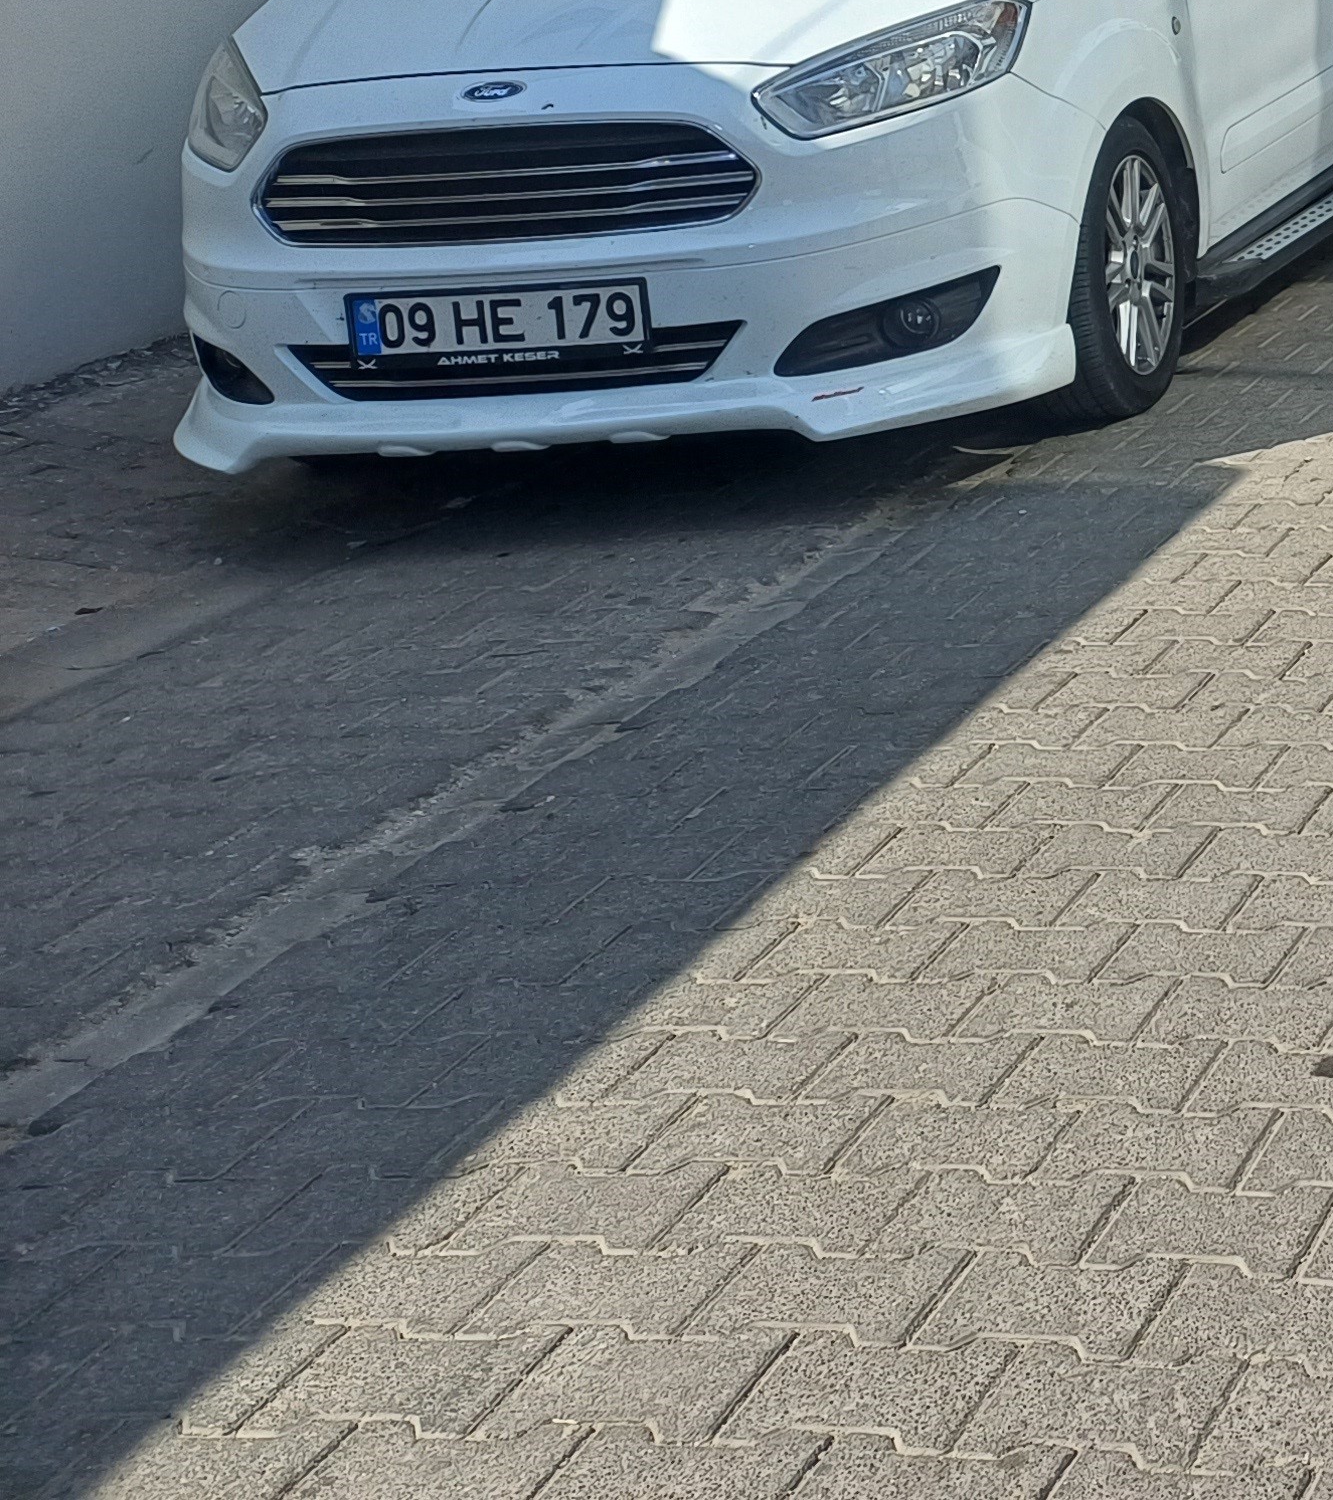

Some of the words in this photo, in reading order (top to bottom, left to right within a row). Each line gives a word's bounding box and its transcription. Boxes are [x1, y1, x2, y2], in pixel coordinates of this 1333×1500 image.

[359, 332, 378, 346] TR
[379, 302, 436, 348] 09
[452, 298, 525, 345] HE
[547, 292, 636, 340] 179
[437, 354, 499, 366] AHMET
[503, 350, 560, 363] KESER
